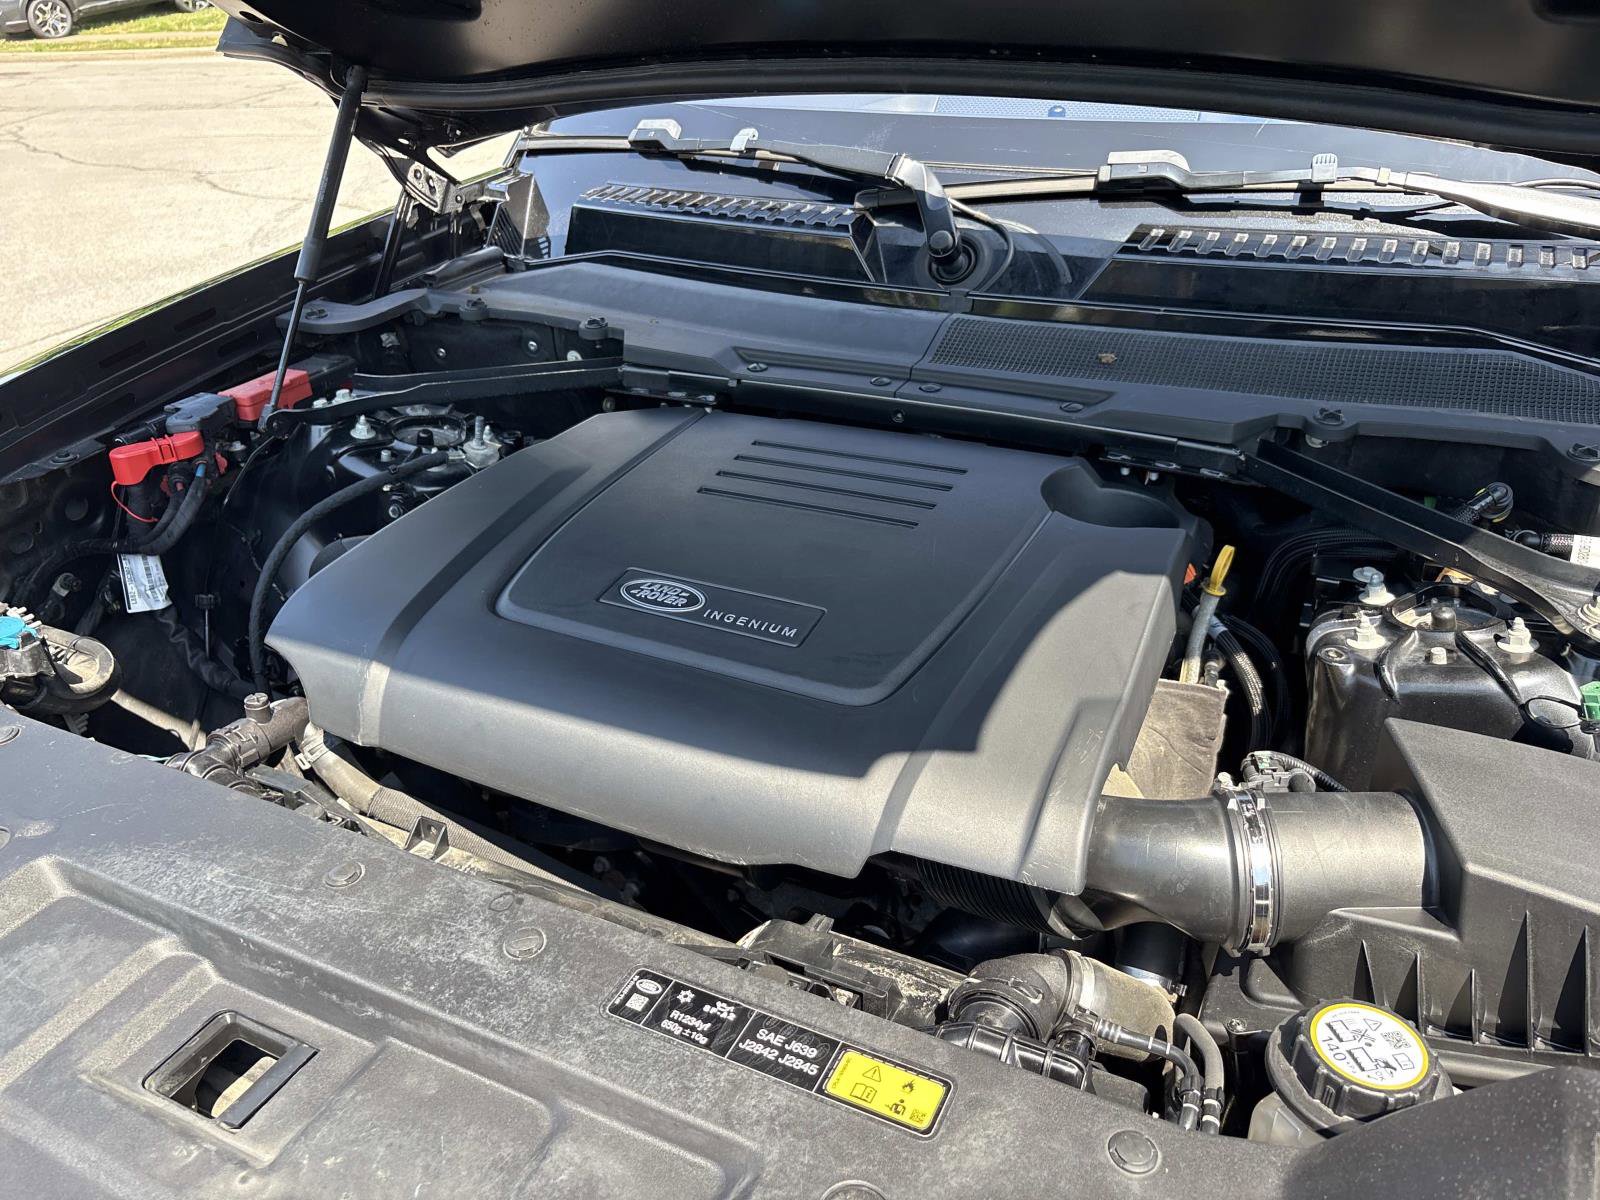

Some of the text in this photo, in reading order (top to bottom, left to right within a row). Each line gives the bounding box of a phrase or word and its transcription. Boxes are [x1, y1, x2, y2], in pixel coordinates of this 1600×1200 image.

[636, 590, 688, 607] ROVER
[640, 582, 680, 596] LAND
[703, 608, 798, 638] INGENIUM
[660, 1019, 684, 1035] 650g
[669, 1009, 712, 1032] R1234yf
[756, 1028, 818, 1059] SAE J639
[1321, 1035, 1347, 1062] 140
[738, 1039, 779, 1061] J2842
[778, 1052, 820, 1076] J2845
